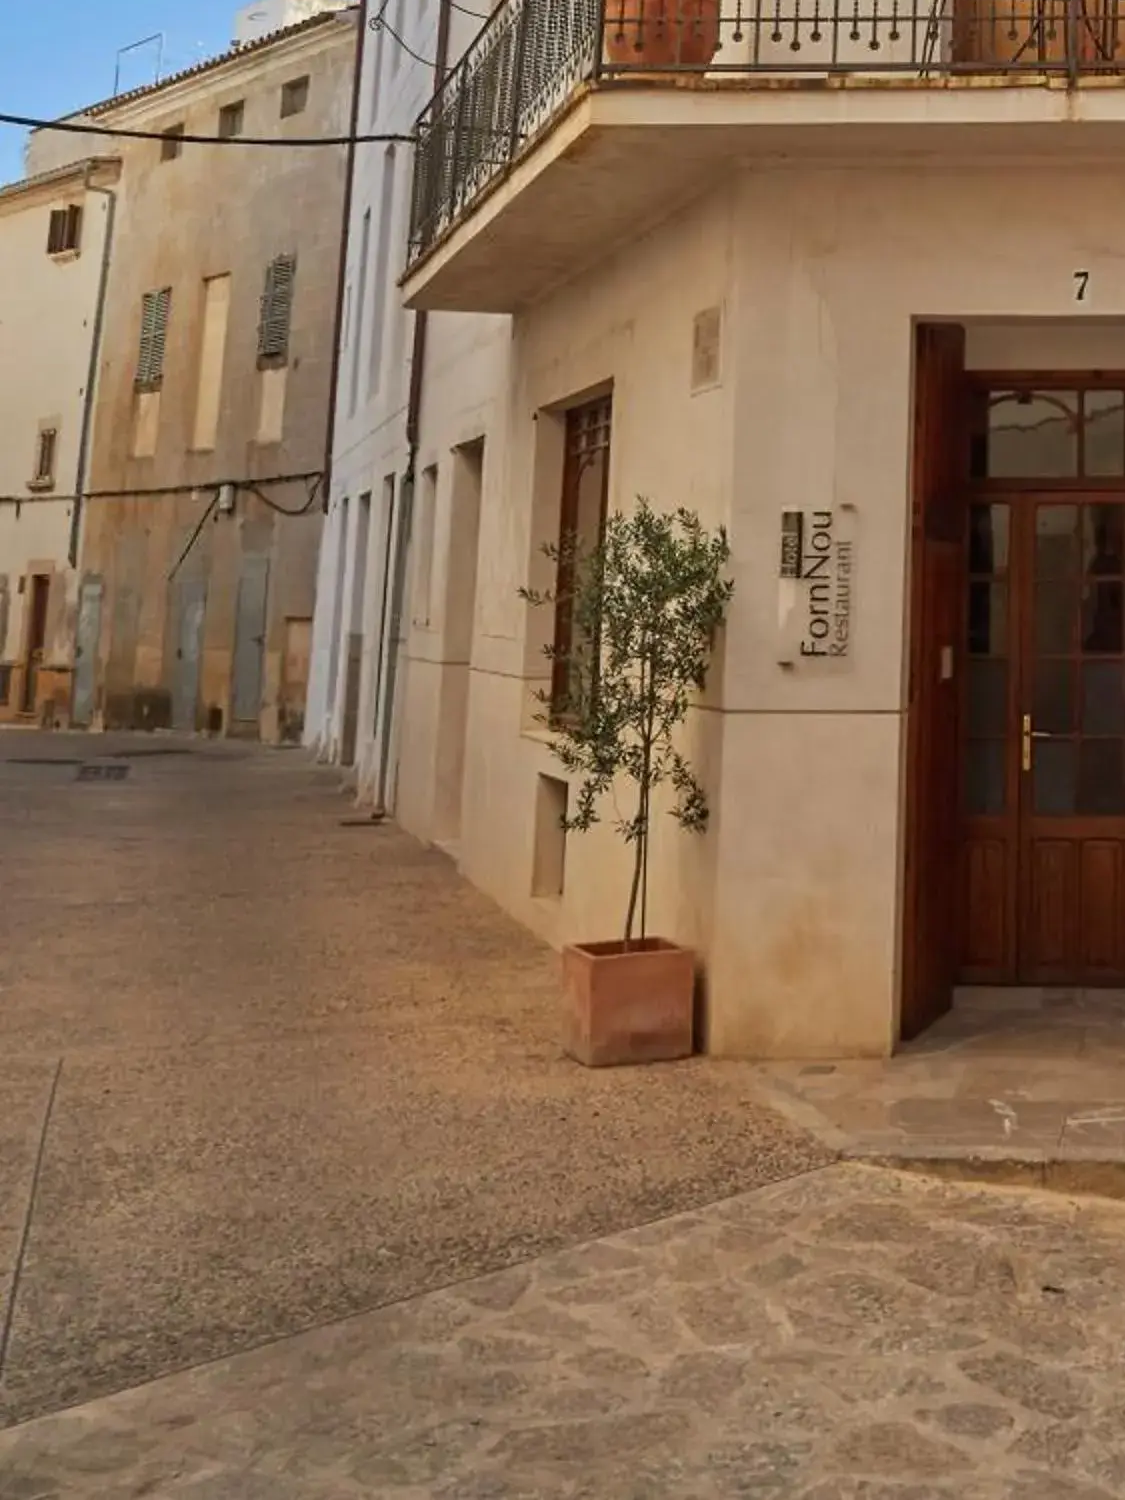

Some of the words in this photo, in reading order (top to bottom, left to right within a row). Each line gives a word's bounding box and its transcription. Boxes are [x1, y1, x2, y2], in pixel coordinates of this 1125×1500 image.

[1073, 271, 1089, 301] 7
[781, 532, 798, 578] Hotel
[800, 511, 833, 657] FornNou
[829, 540, 852, 657] Restaurant
